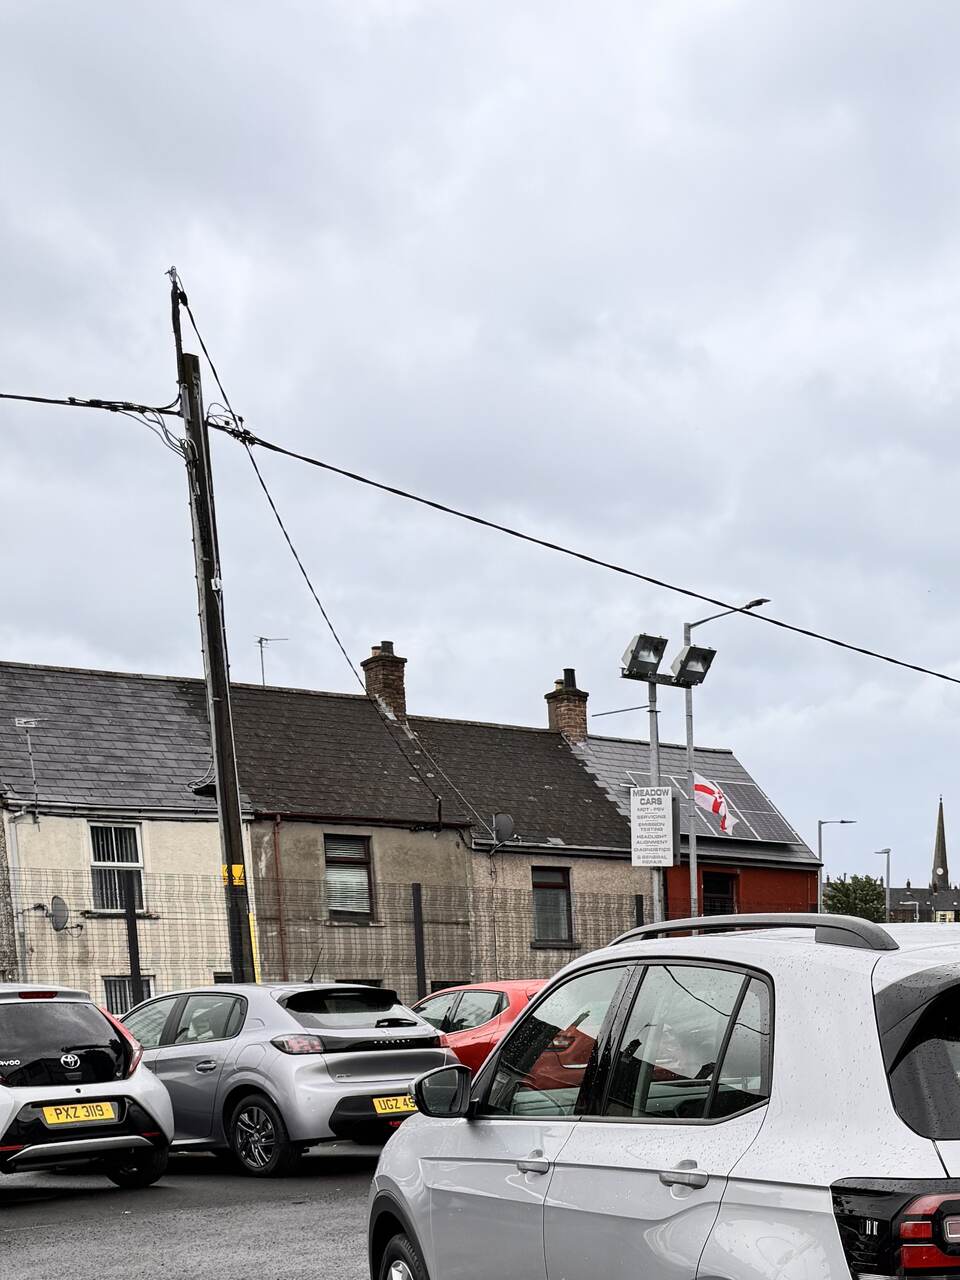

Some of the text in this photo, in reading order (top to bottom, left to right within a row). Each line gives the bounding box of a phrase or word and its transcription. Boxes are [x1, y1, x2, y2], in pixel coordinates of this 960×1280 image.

[632, 789, 669, 797] MEADOW
[640, 797, 663, 805] CARS
[378, 1098, 401, 1110] UGZ
[54, 1104, 104, 1120] PXZ 3119
